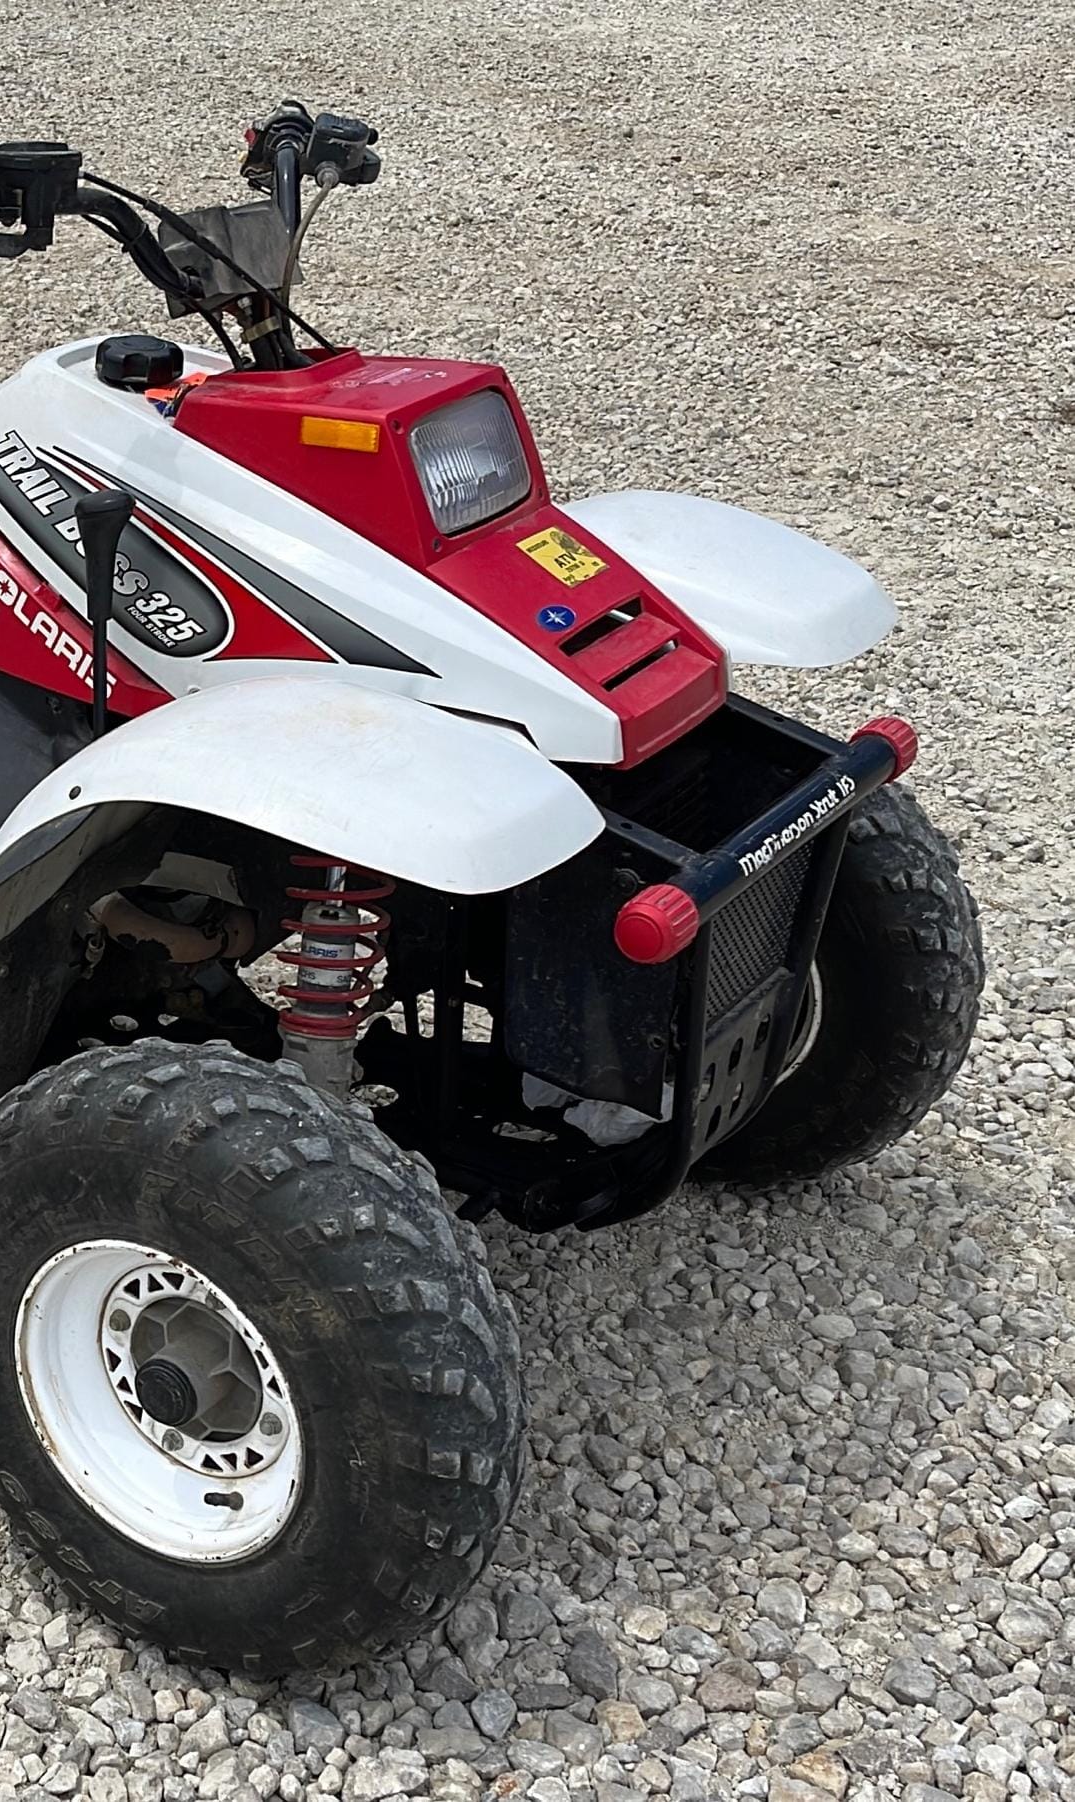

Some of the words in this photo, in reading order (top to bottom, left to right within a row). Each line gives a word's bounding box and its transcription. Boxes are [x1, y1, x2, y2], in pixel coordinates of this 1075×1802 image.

[52, 514, 149, 596] BSS
[134, 590, 208, 642] 325
[554, 551, 577, 568] ATV
[126, 606, 148, 624] FOUR
[145, 622, 177, 648] STROKE
[809, 789, 840, 819] Strut
[836, 774, 856, 797] IFS
